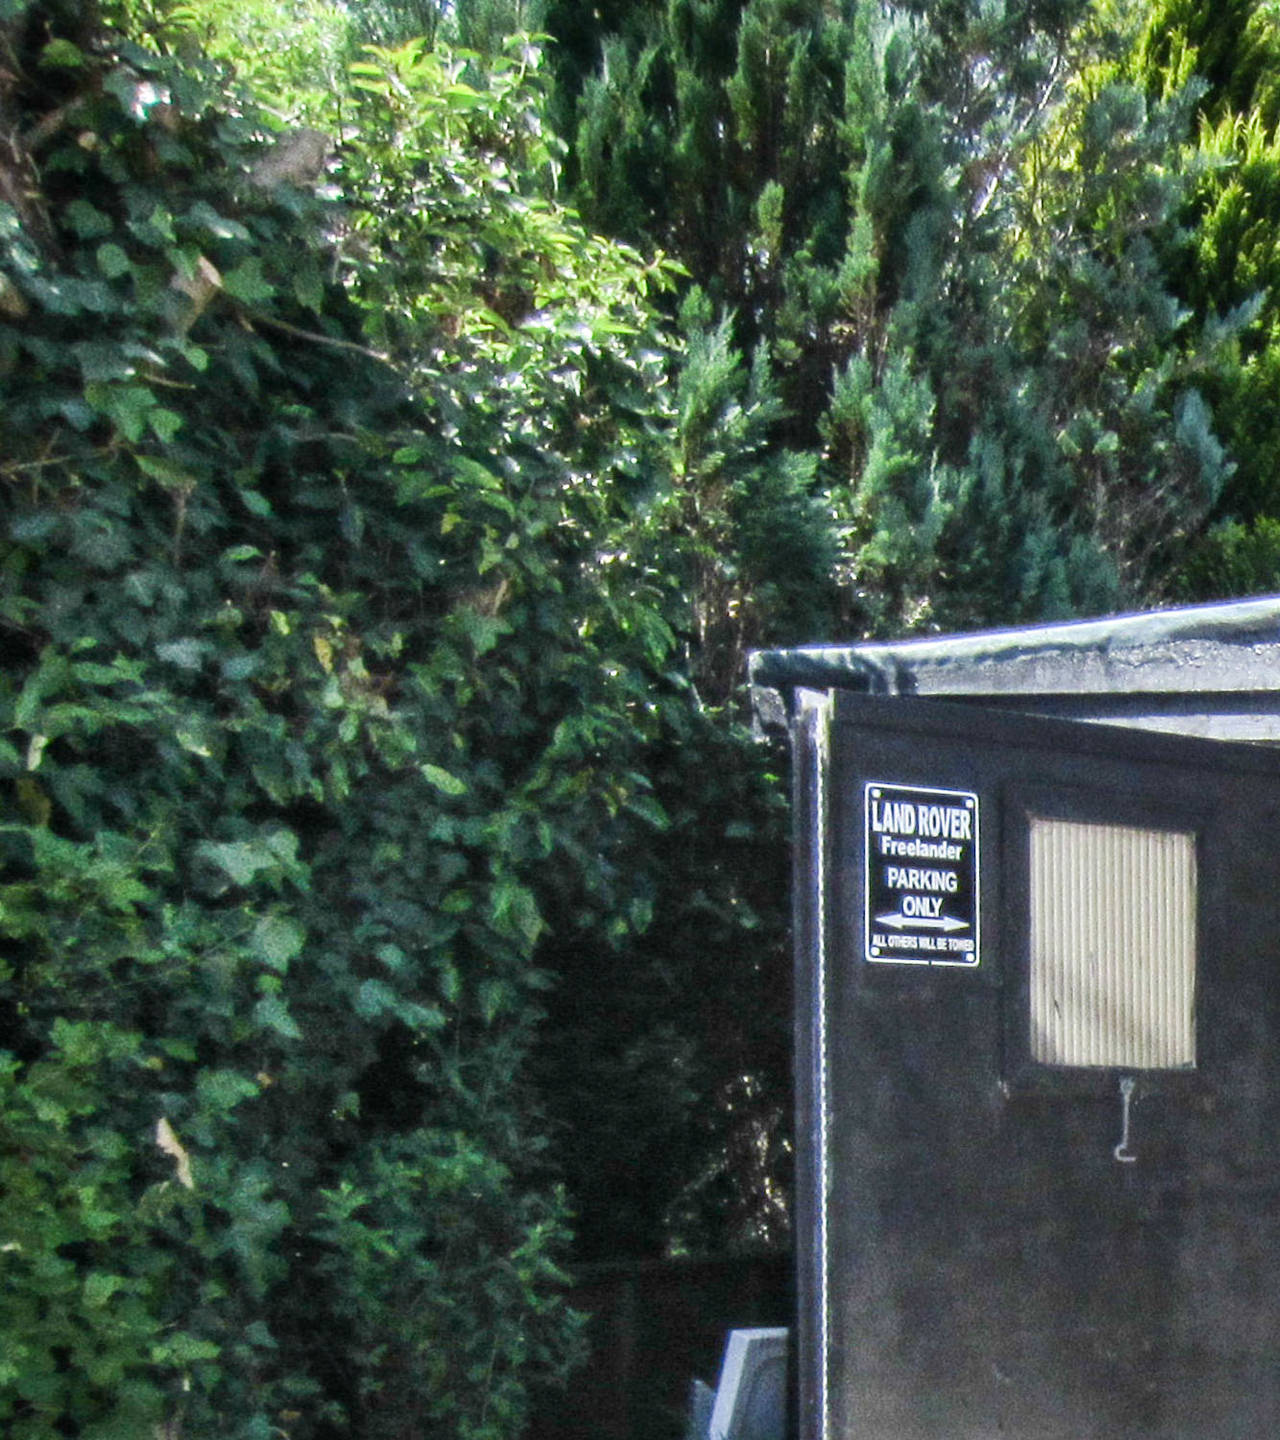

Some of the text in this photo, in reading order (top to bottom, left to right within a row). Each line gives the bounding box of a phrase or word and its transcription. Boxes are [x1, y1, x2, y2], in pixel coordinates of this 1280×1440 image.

[872, 801, 971, 839] LAND ROVER
[881, 836, 963, 860] Freelander
[887, 867, 958, 892] PARKING
[903, 896, 943, 917] ONLY
[872, 934, 975, 952] ALL OTHERS WILL BE TOWED
